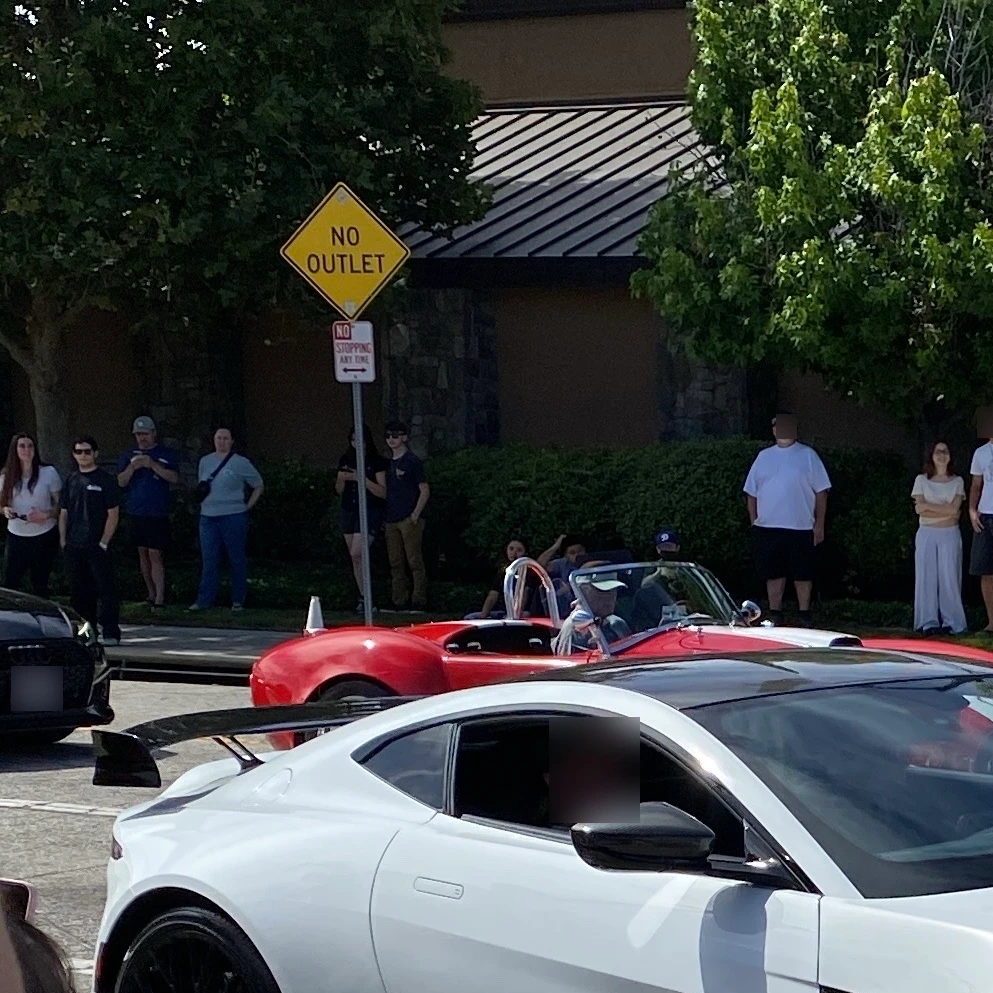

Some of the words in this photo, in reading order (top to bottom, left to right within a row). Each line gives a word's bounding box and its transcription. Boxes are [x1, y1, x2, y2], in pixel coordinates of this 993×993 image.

[332, 227, 360, 246] NO
[307, 253, 385, 274] OUTLET
[336, 324, 350, 338] NO
[336, 342, 372, 354] STOPPING
[340, 355, 353, 364] ANY
[355, 355, 370, 364] TIME
